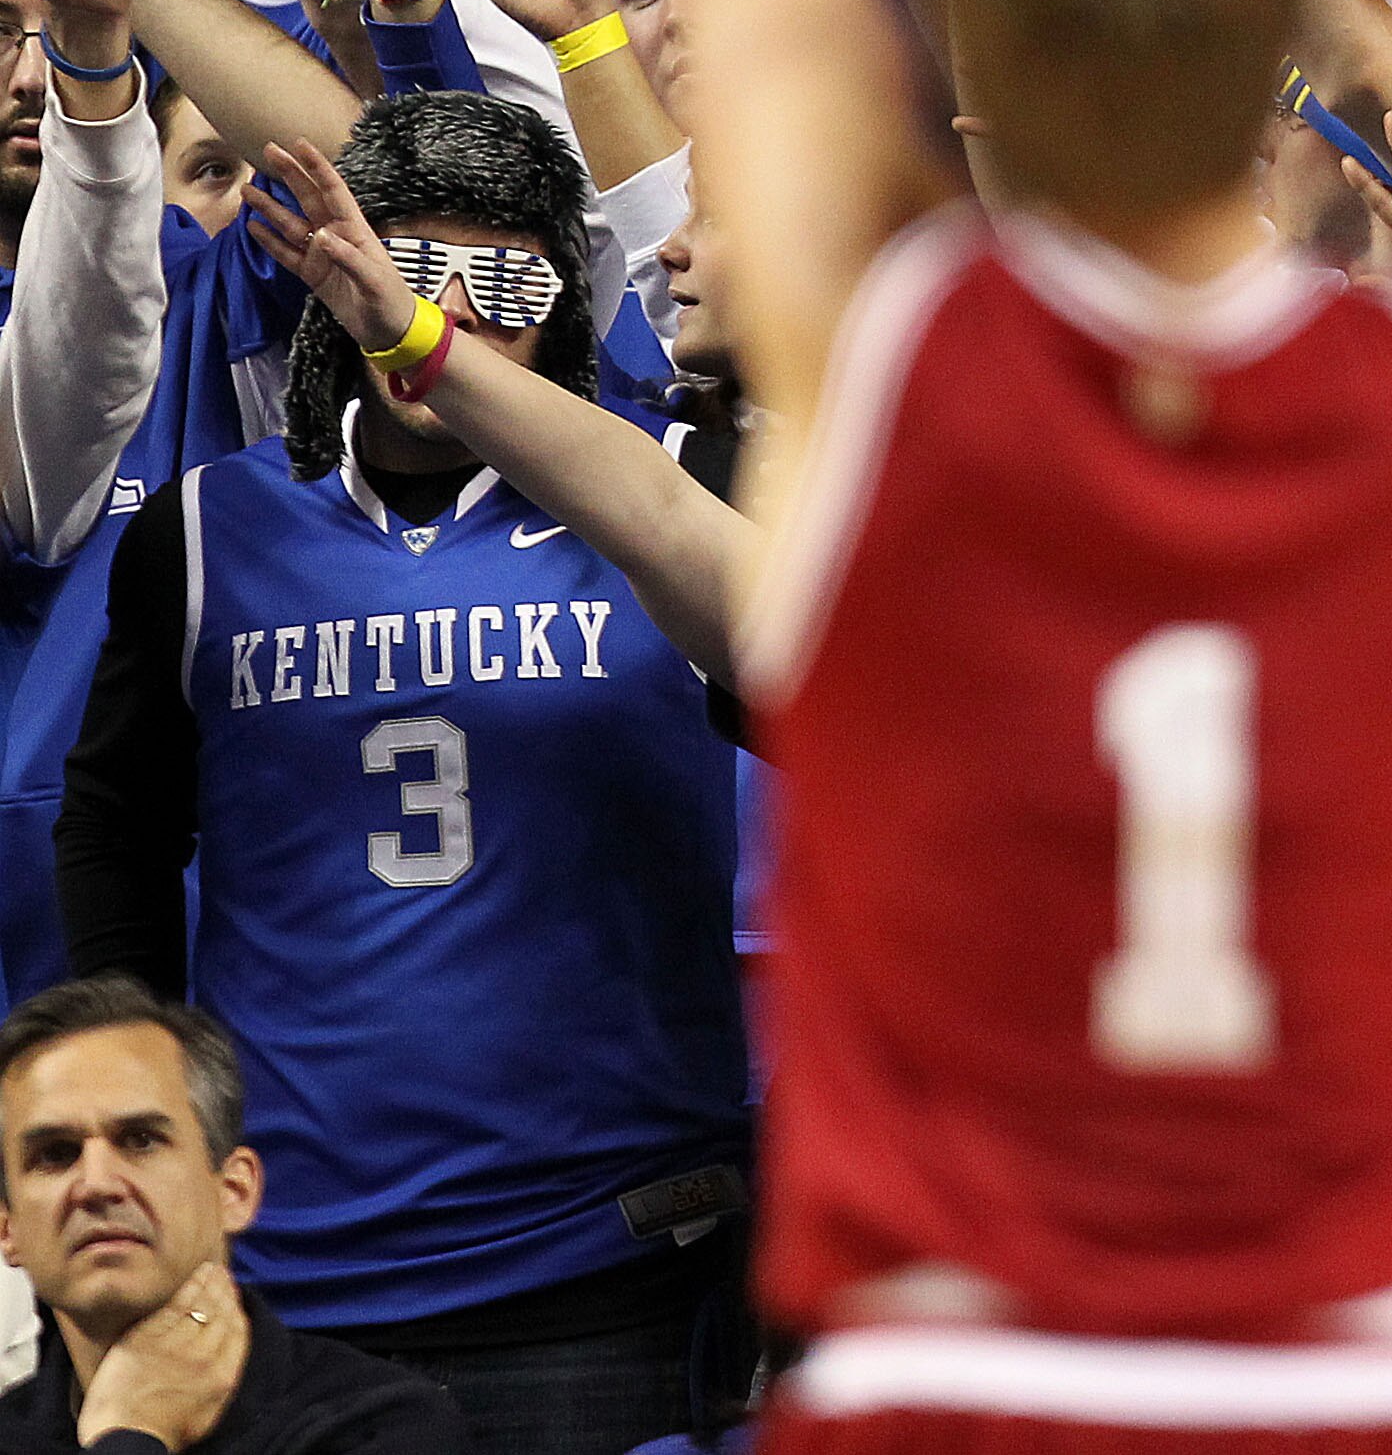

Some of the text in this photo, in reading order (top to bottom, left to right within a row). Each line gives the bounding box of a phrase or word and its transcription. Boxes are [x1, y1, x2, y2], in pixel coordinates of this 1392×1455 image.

[230, 600, 612, 709] KENTUCKY
[361, 715, 474, 888] 3
[1090, 619, 1284, 1077] 1
